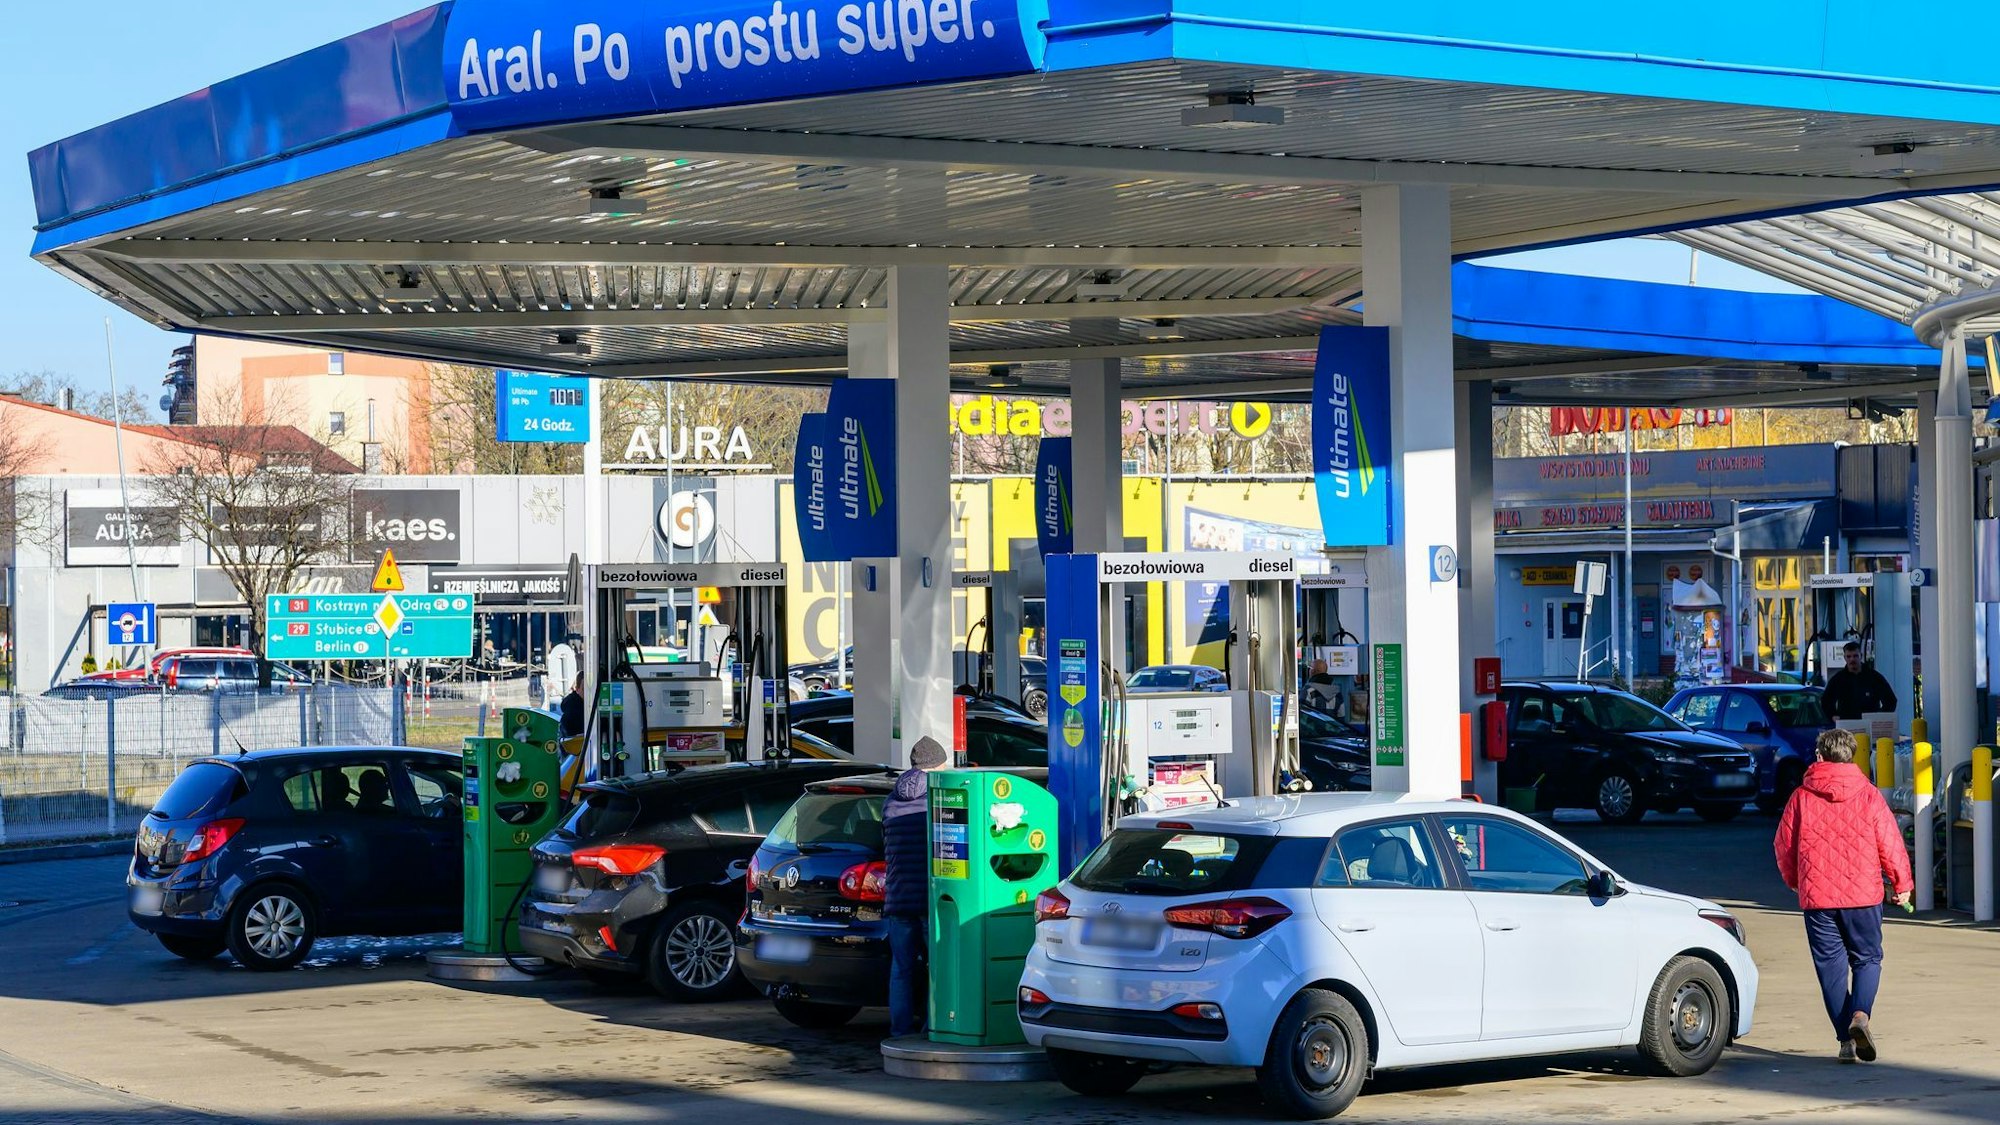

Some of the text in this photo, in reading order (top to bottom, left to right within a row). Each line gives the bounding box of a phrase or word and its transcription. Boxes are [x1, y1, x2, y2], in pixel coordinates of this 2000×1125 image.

[458, 0, 994, 100] Aral. Po prostu super.
[524, 418, 575, 432] 24 Godz.
[1329, 370, 1349, 498] ultimate
[624, 425, 753, 461] AURA
[839, 416, 859, 520] ultimate
[1717, 454, 1766, 470] KUCHENNE
[811, 445, 824, 531] ultimate
[1045, 464, 1058, 537] ultimate
[95, 523, 154, 541] AURA
[365, 511, 456, 542] kaes.
[1104, 558, 1293, 575] bezołowiowa diesel
[1437, 555, 1450, 573] 12
[601, 569, 784, 582] bezołowiowa diesel
[962, 575, 990, 584] diesel
[1301, 577, 1346, 586] bezołowiowa
[1857, 576, 1872, 584] diesel
[1914, 573, 1921, 582] 2
[444, 578, 519, 593] RZEMIEŚLNICZA
[522, 577, 560, 593] JAKOŚĆ
[293, 601, 304, 610] 31
[315, 599, 368, 614] Kostrzyn
[400, 599, 431, 614] Odrą
[436, 600, 445, 609] PL
[292, 624, 305, 634] 29
[316, 623, 362, 635] Słubice
[316, 640, 350, 652] Berlin
[1153, 721, 1162, 729] 12
